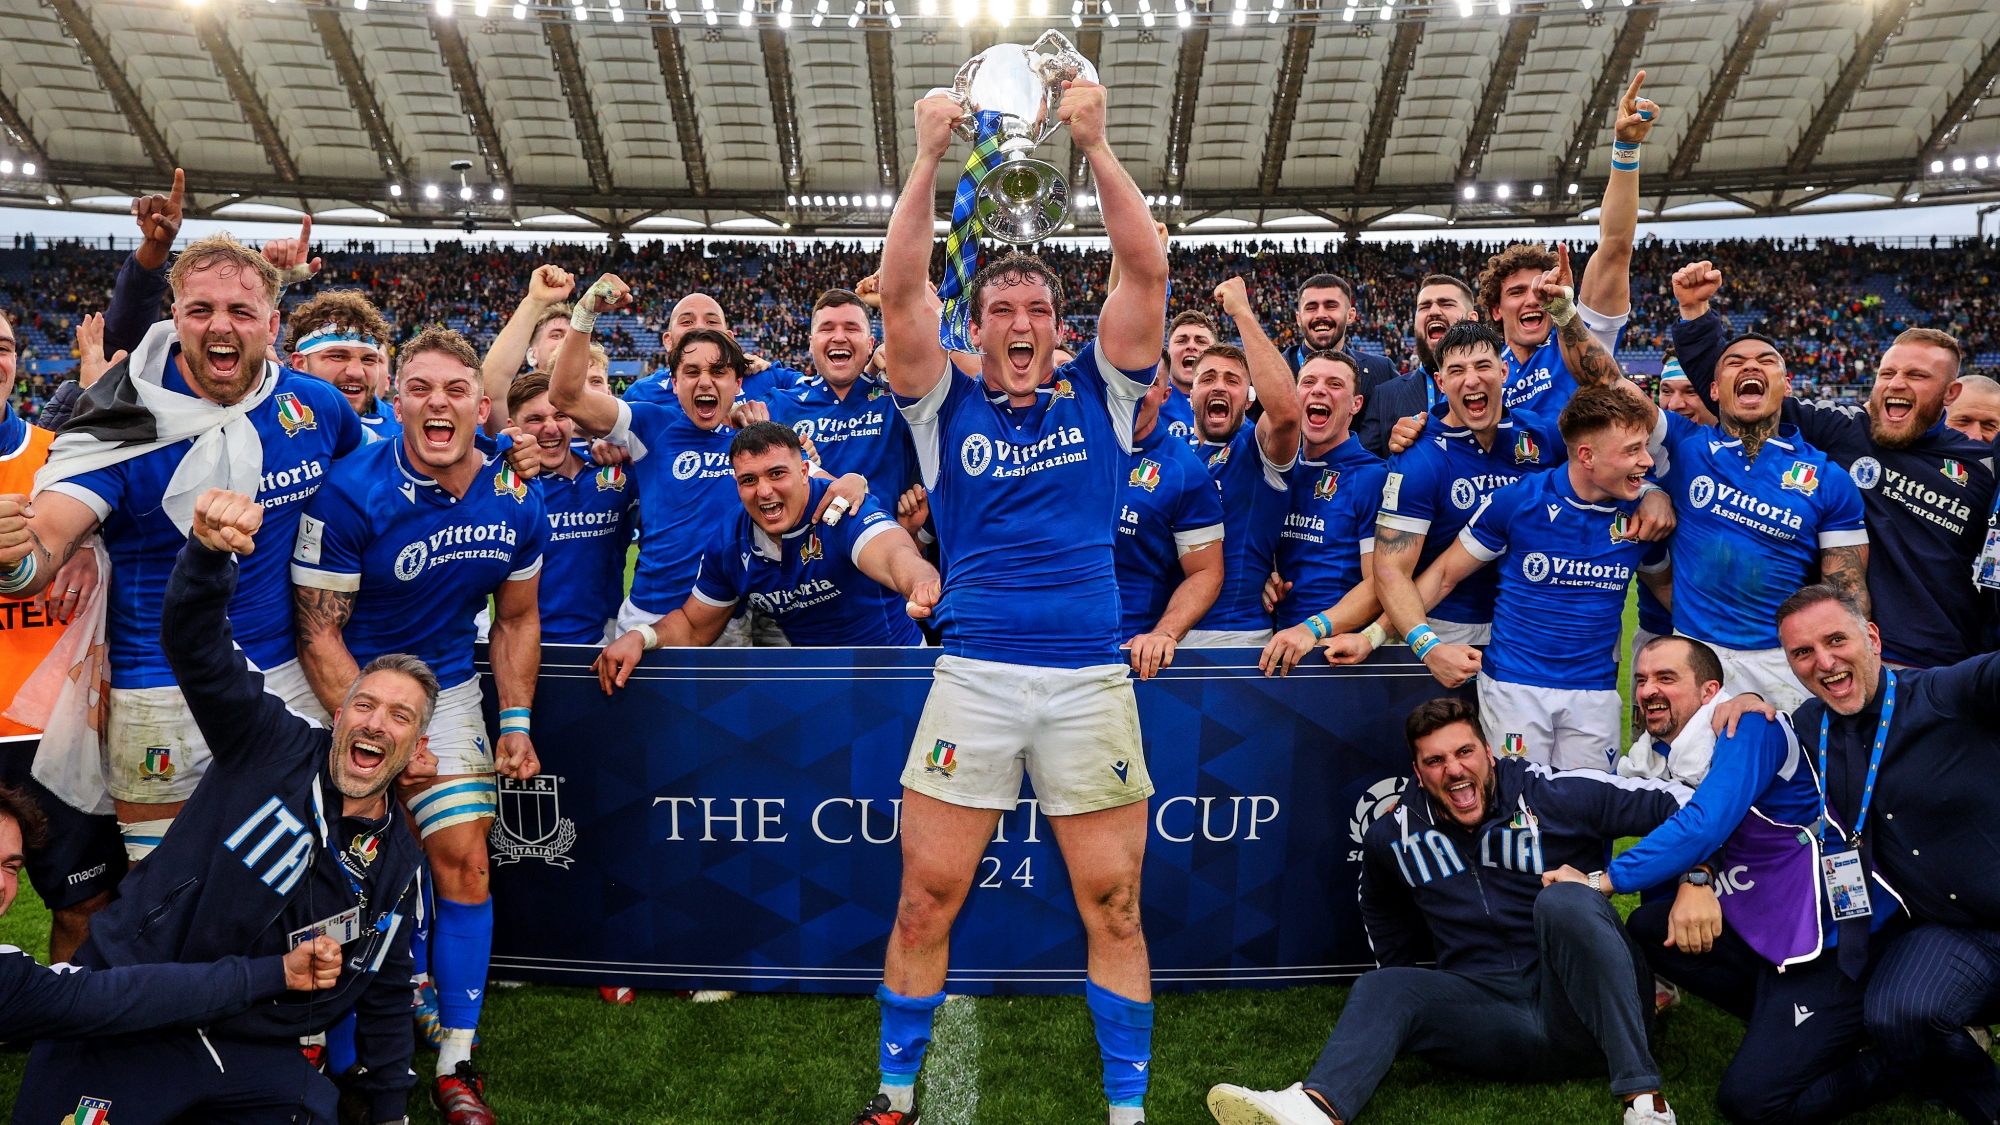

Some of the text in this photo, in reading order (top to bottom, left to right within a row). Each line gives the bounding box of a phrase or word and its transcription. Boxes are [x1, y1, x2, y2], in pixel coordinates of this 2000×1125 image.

[259, 460, 323, 493] ttoria
[992, 449, 1088, 478] Assicurazioni
[1717, 483, 1803, 530] Vittoria
[1885, 467, 1971, 522] Vittoria
[547, 509, 619, 529] Vittoria
[1284, 512, 1325, 532] ittoria
[1710, 503, 1796, 541] Assicurazioni
[429, 520, 517, 552] Vittoria
[428, 547, 512, 570] Assicurazioni
[1552, 556, 1630, 579] Vittoria
[504, 777, 552, 791] F.I.R.
[652, 796, 788, 843] THE
[1155, 795, 1280, 843] CUP
[513, 847, 551, 857] ITALIA
[67, 862, 106, 885] macron
[979, 856, 1034, 889] 24
[83, 1099, 107, 1110] F.I.R.
